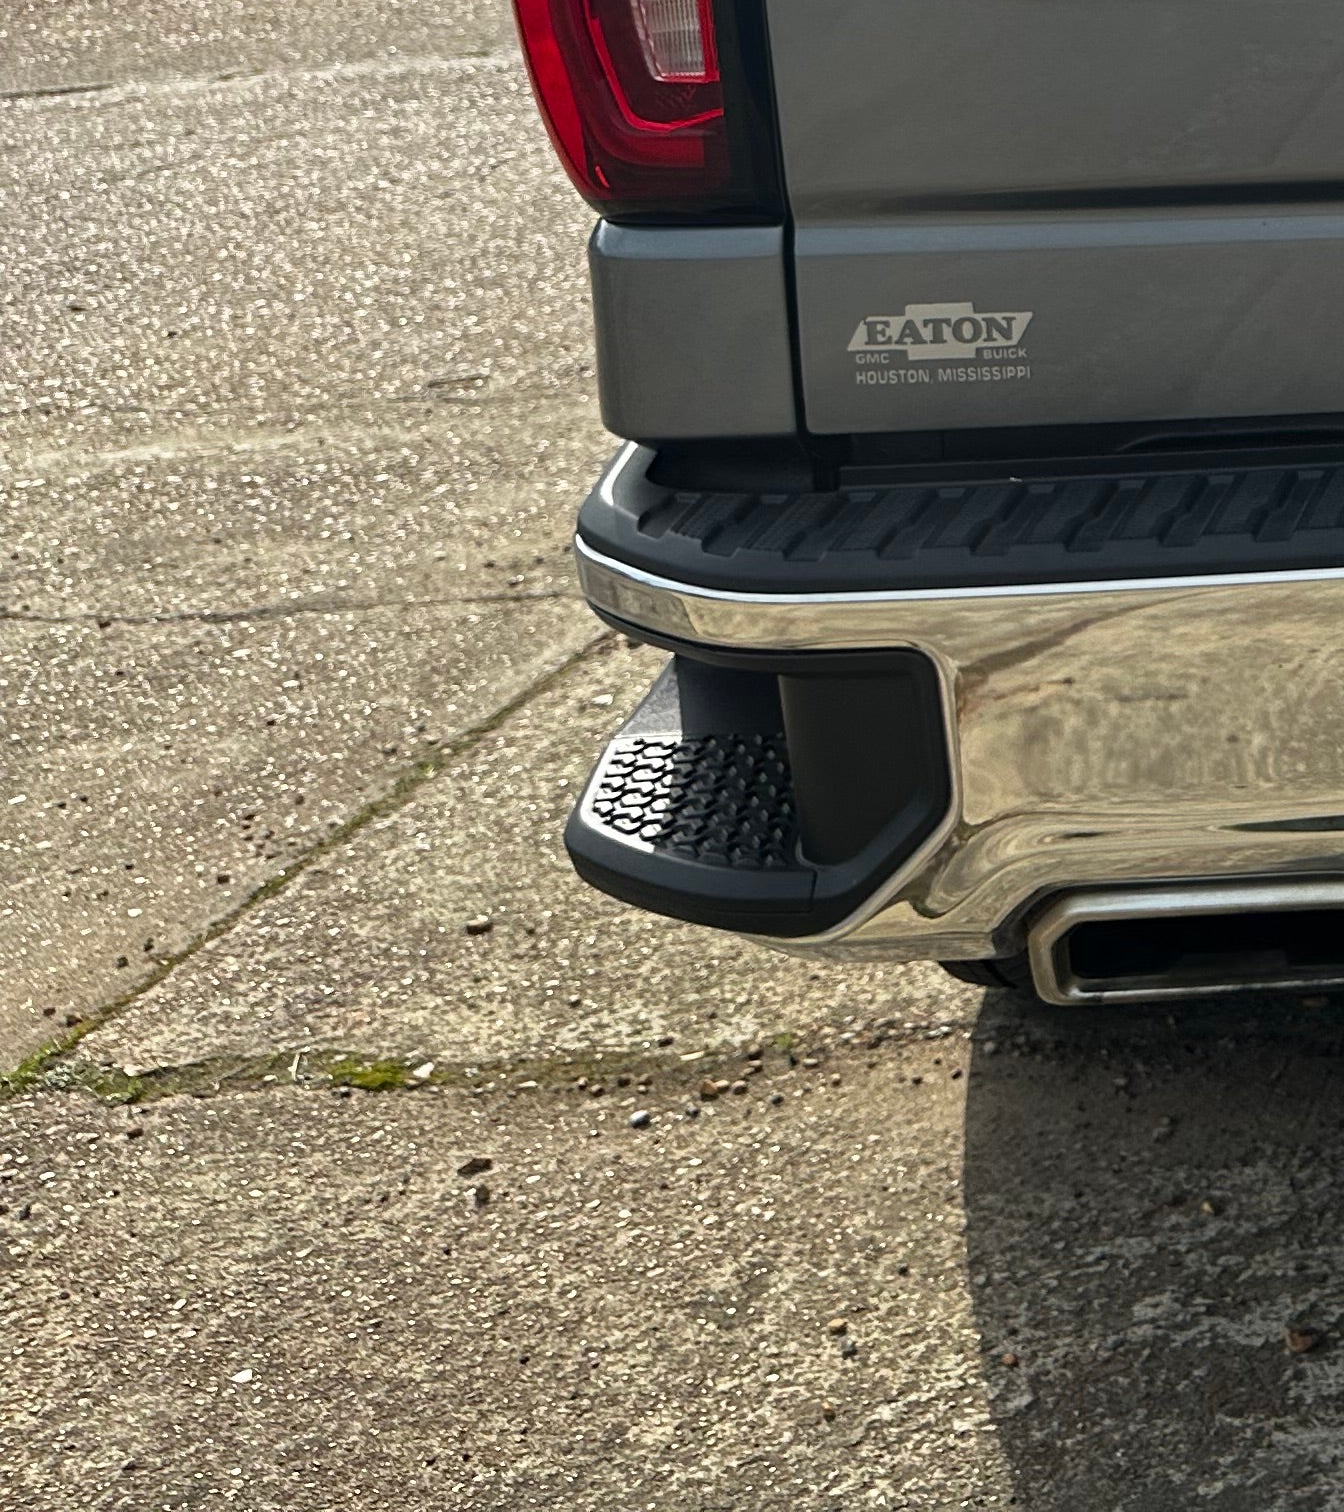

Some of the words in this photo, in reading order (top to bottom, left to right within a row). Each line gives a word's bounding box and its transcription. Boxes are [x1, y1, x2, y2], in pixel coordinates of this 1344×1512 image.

[864, 316, 1016, 345] EATON
[855, 353, 890, 364] GMC
[983, 348, 1028, 360] BUICK
[856, 368, 934, 385] HOUSTON,
[938, 366, 1031, 382] MISSISSIPPI
